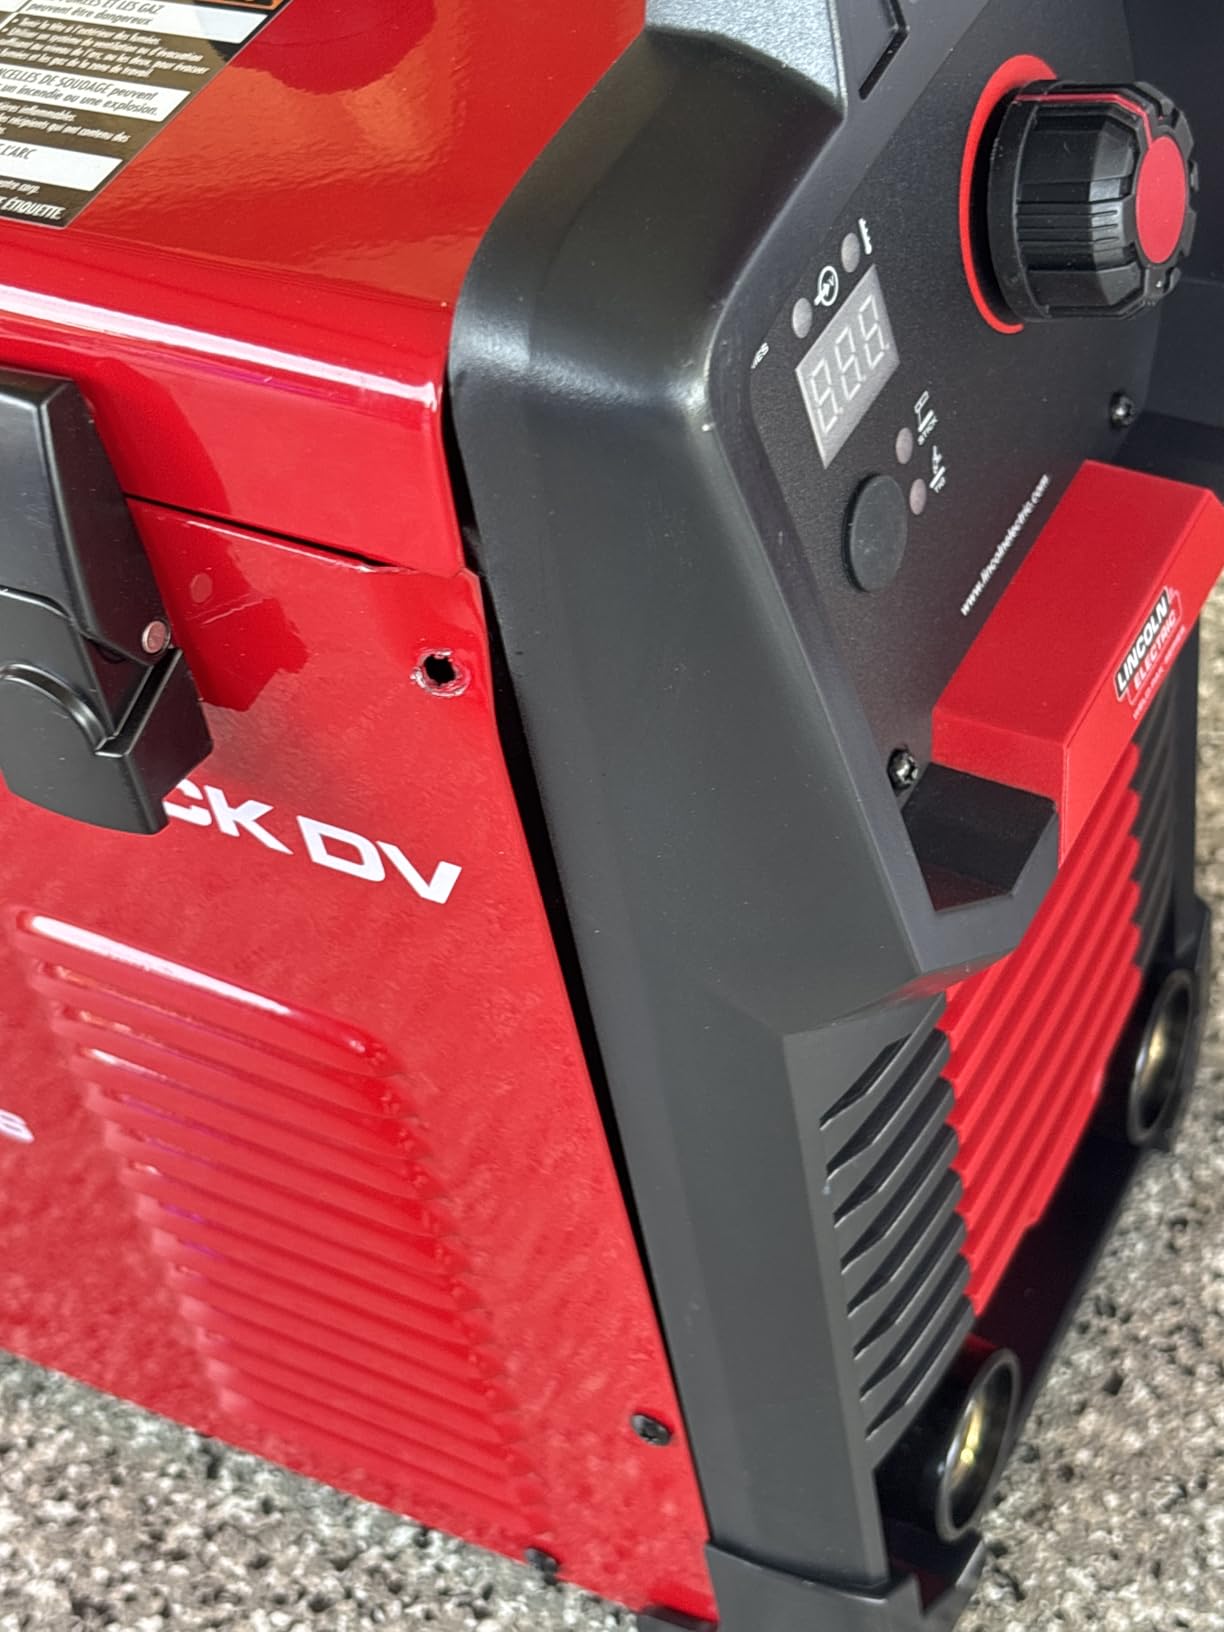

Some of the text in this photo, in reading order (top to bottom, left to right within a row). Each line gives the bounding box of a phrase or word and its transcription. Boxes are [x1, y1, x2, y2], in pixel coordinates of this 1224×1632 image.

[136, 3, 165, 15] GAZ
[16, 85, 63, 100] incendie
[79, 97, 103, 106] une
[102, 100, 158, 116] explosion.
[38, 74, 59, 86] DE
[55, 77, 114, 94] SOUDAGE
[107, 88, 158, 102] peuvent
[960, 474, 1050, 616] www.lincolnelectric.com
[1116, 596, 1169, 692] LINCOLN
[1133, 608, 1177, 690] ELECTRIC
[296, 815, 463, 904] DV
